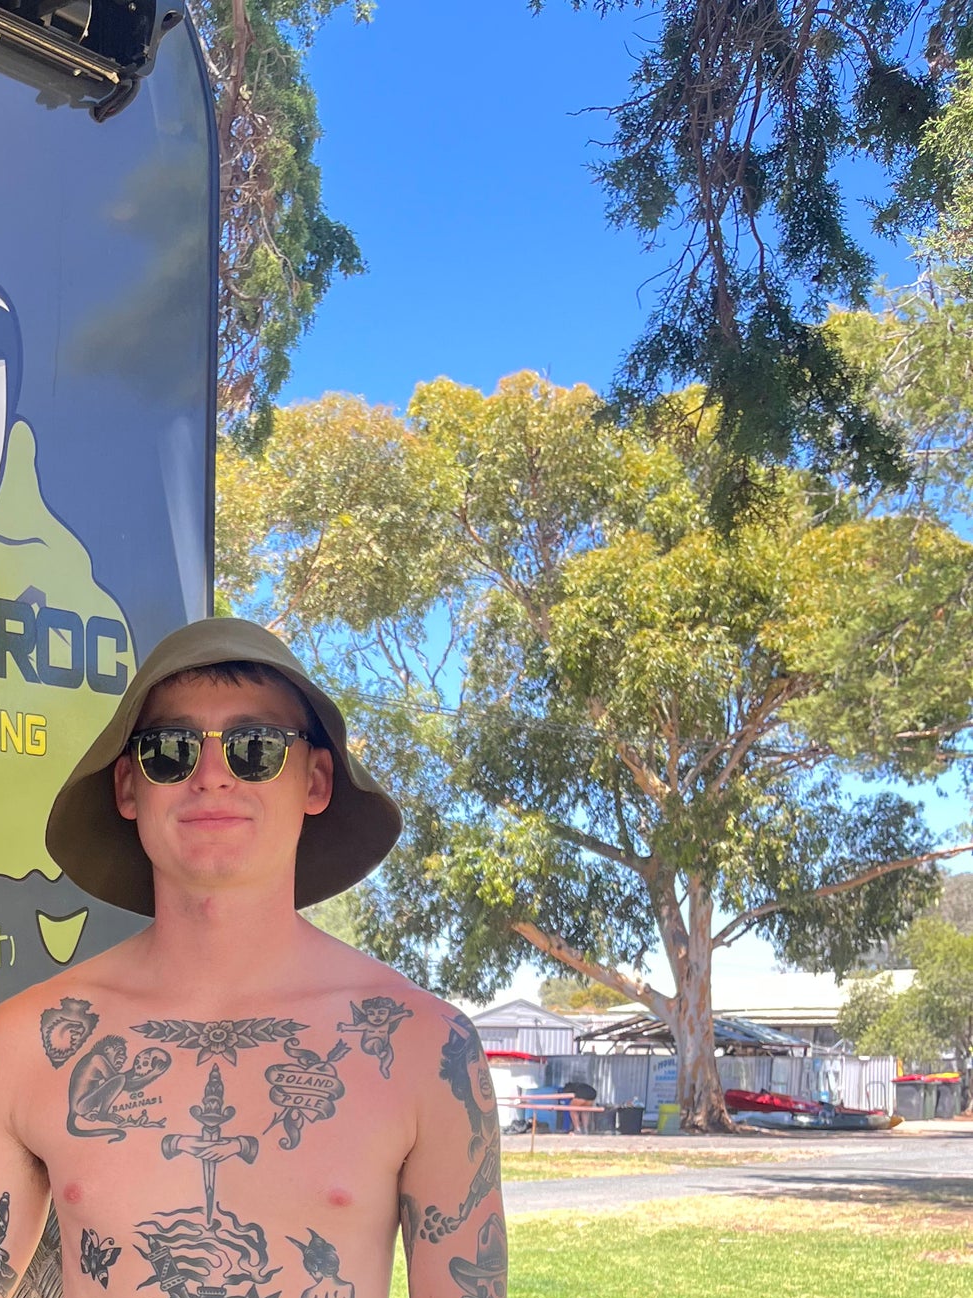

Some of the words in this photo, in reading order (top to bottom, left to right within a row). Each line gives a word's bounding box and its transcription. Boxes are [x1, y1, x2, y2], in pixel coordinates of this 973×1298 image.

[275, 1073, 334, 1088] BOLAND
[130, 1091, 144, 1100] GO
[282, 1093, 325, 1108] POLE
[112, 1095, 163, 1113] BANANAS!
